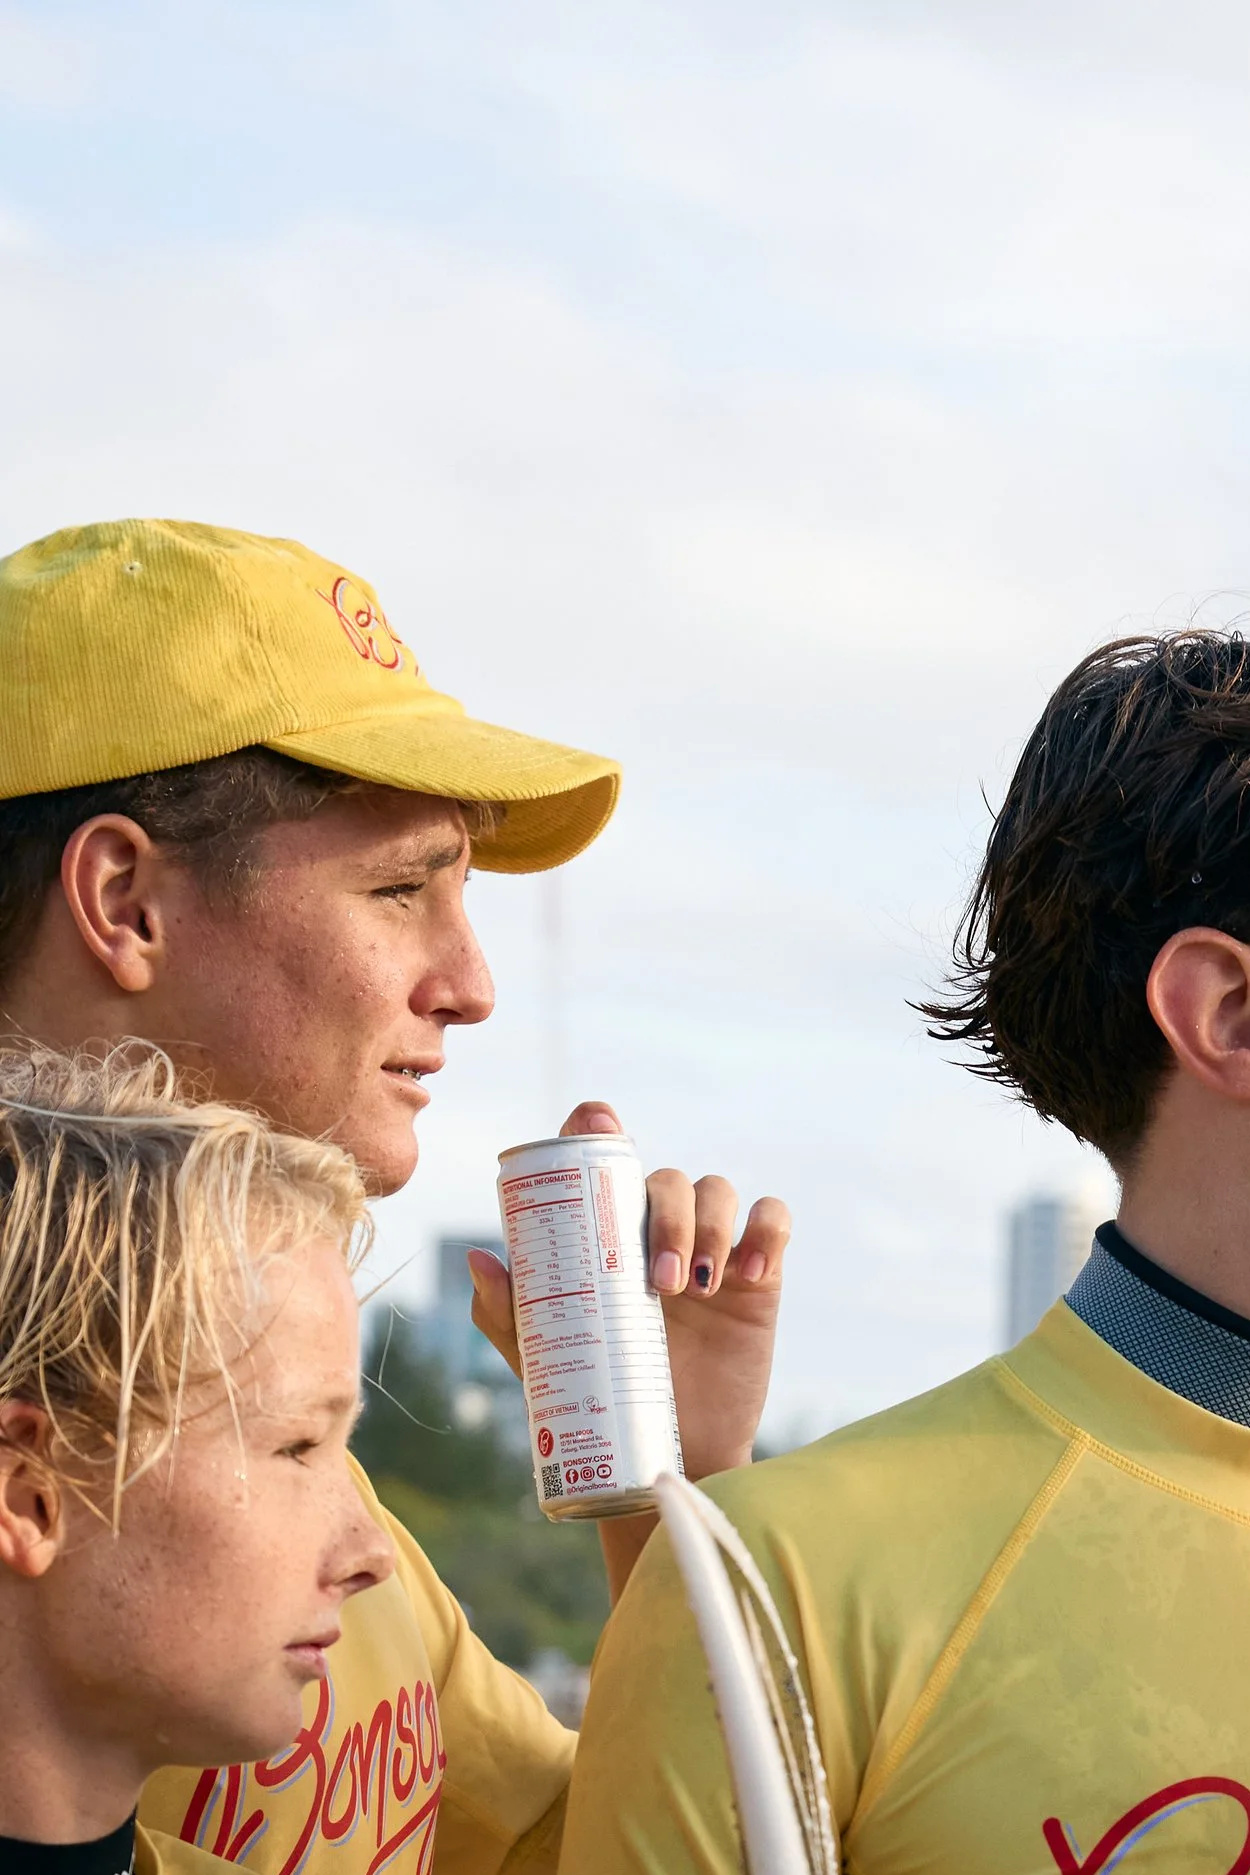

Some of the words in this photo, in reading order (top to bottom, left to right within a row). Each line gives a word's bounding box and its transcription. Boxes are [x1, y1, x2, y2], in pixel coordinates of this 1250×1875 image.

[534, 1173, 581, 1185] INFORMATION
[606, 1249, 618, 1270] 10c
[555, 1405, 577, 1414] VIETNAM
[563, 1454, 613, 1467] BONSOY.COM
[567, 1482, 617, 1495] @Originalbonsoy
